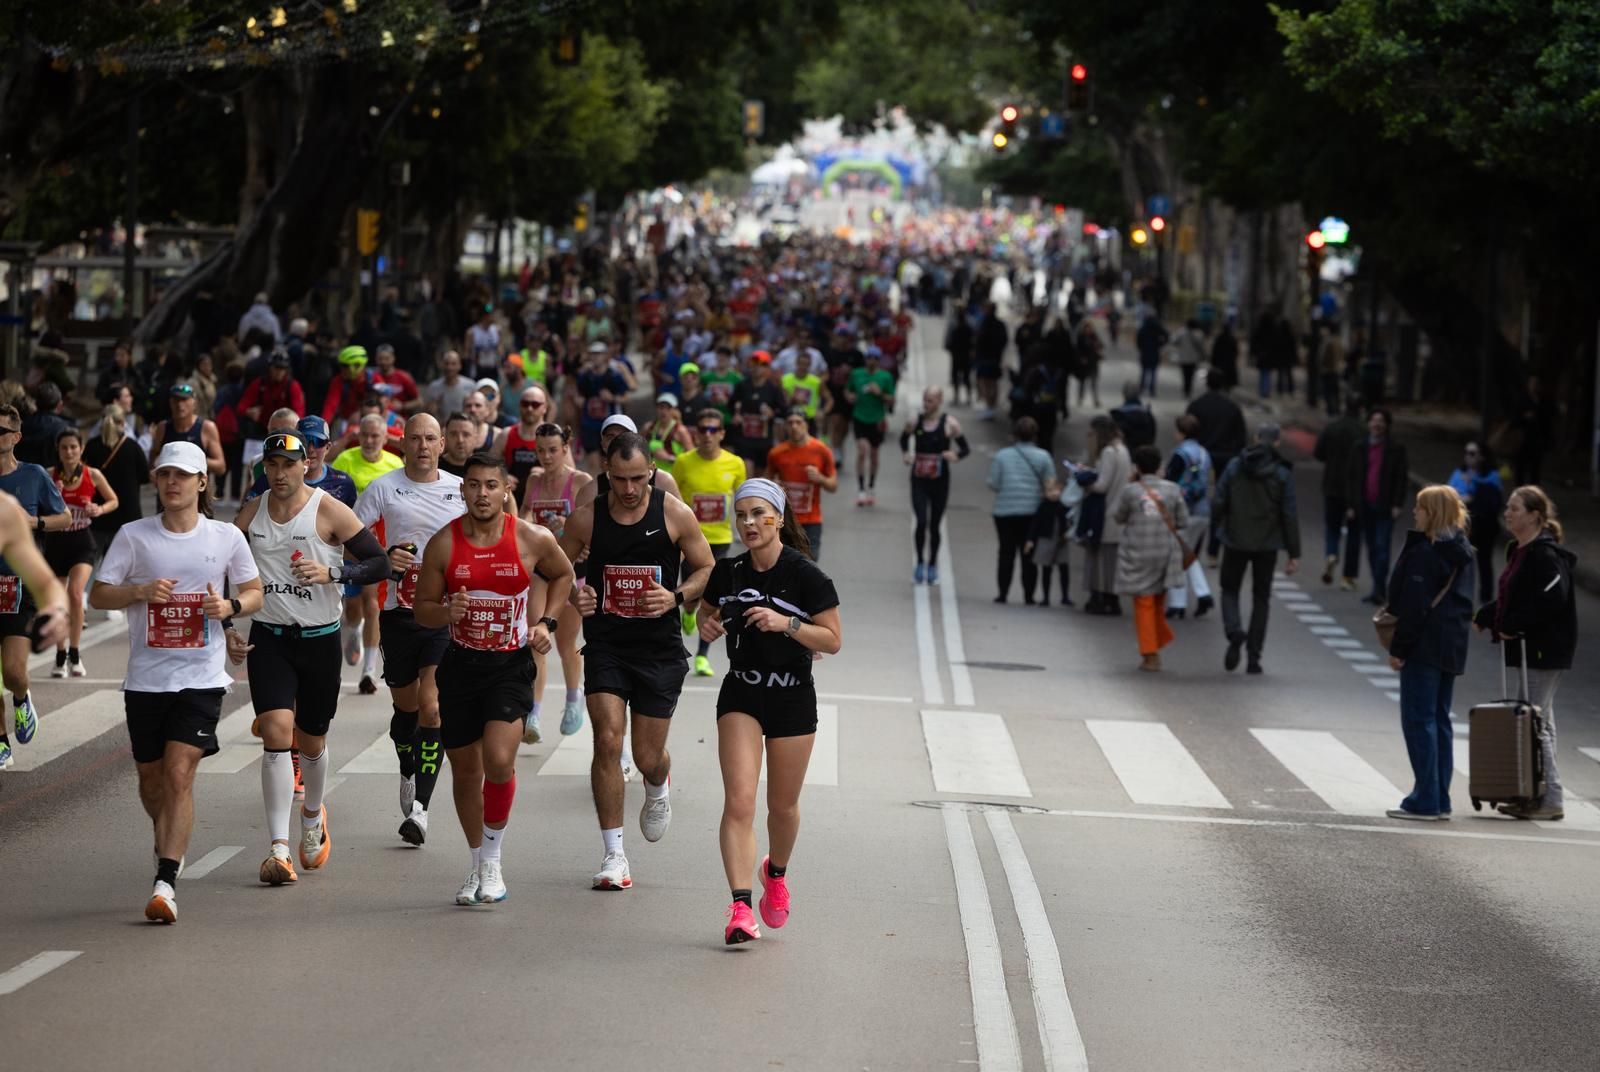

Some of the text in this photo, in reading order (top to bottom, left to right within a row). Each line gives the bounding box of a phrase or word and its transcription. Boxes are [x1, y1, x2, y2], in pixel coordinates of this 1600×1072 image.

[616, 568, 652, 576] GENERALI
[615, 579, 643, 589] 4509
[160, 607, 191, 618] 4513
[466, 610, 495, 622] 1388
